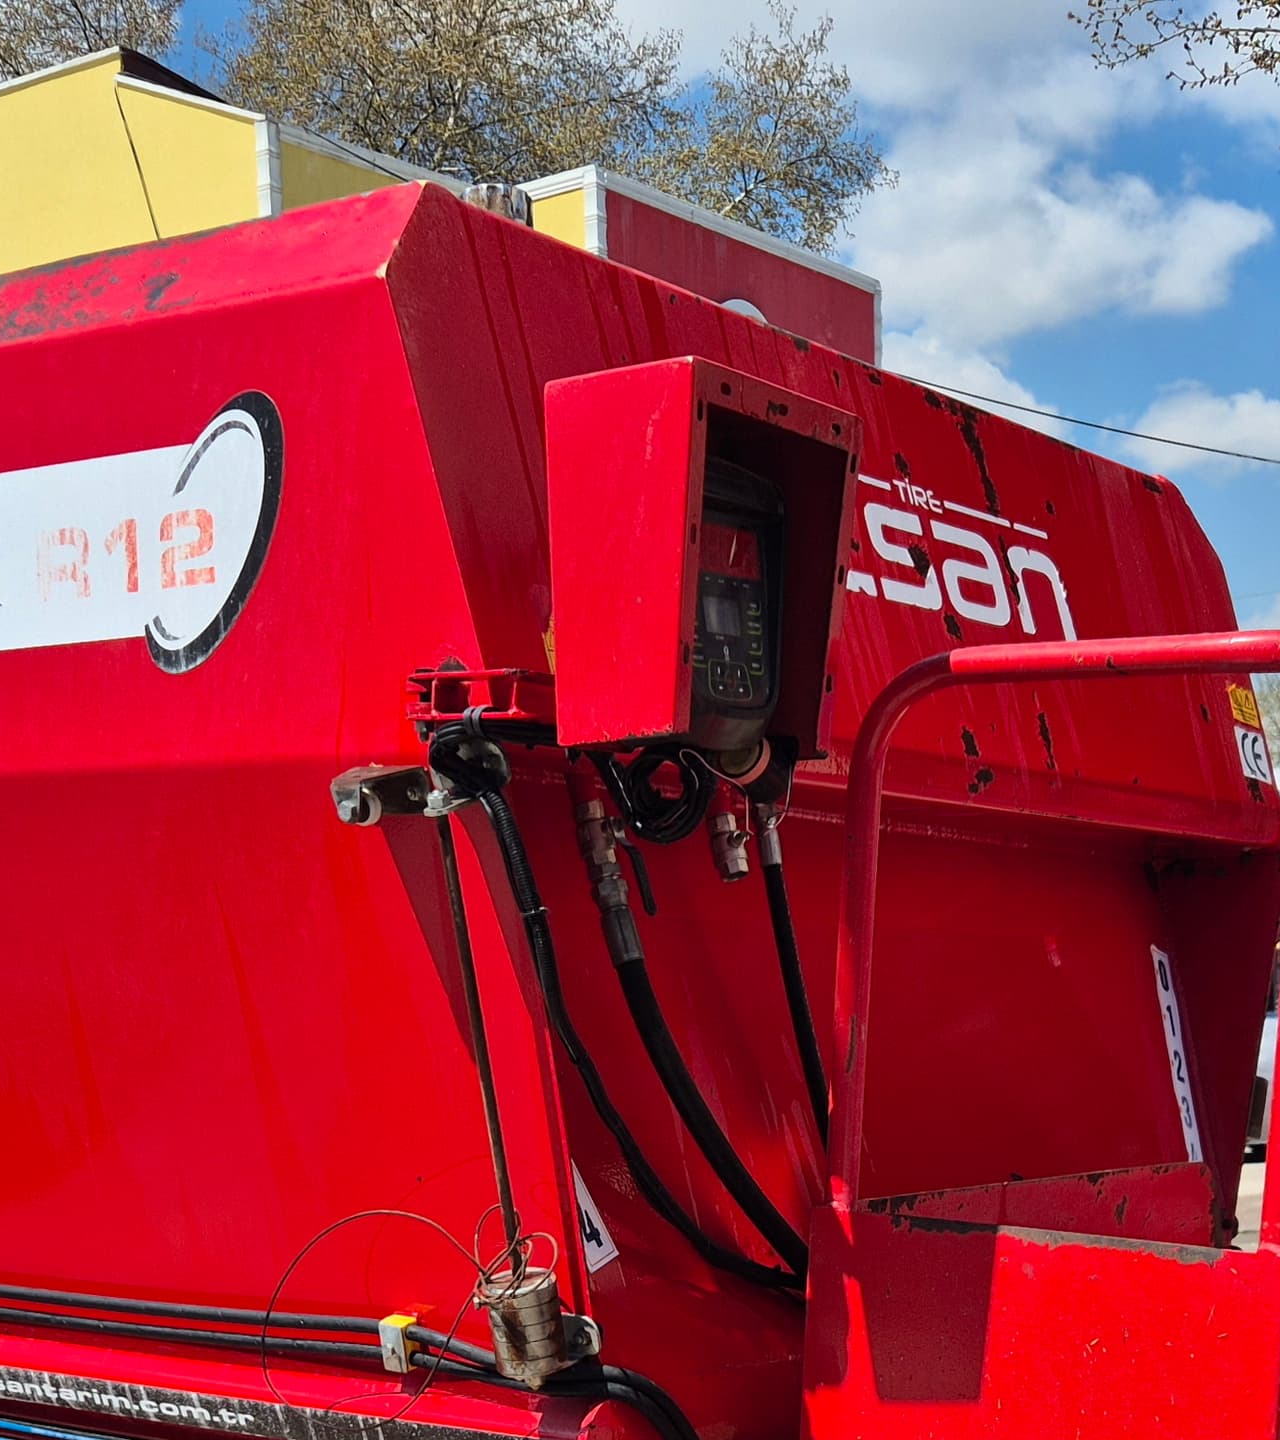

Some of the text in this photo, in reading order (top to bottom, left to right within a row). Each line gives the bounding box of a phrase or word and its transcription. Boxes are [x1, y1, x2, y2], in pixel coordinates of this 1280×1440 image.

[892, 477, 944, 515] TİRE
[35, 507, 216, 603] R12
[1241, 732, 1268, 780] CE
